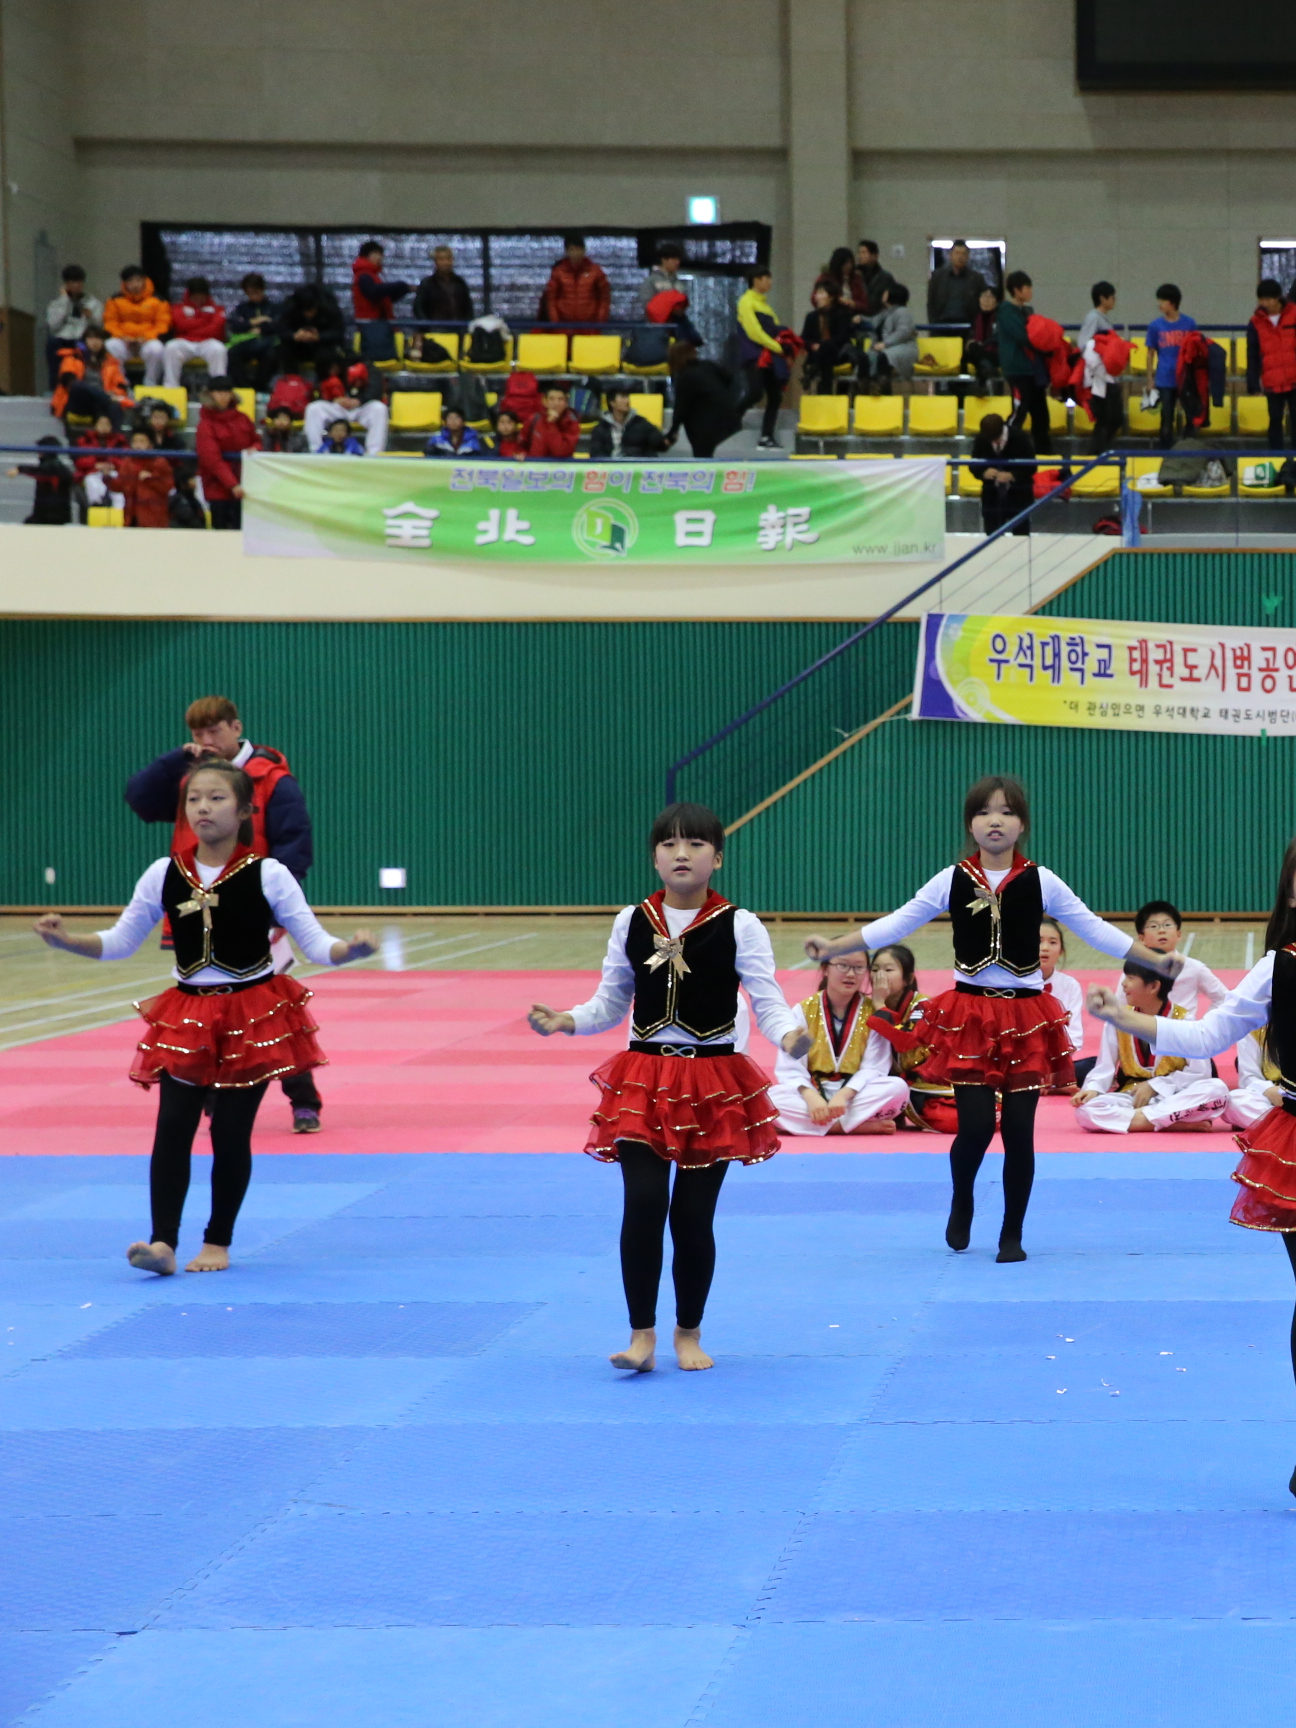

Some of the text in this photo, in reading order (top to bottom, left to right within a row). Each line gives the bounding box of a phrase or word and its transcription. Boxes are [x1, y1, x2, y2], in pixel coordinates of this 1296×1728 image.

[450, 467, 575, 493] 전북일보의
[639, 469, 717, 494] 전북의
[852, 541, 936, 556] www.jjan.kr
[988, 632, 1115, 686] 우석대학교
[1152, 704, 1212, 721] 우석대학교
